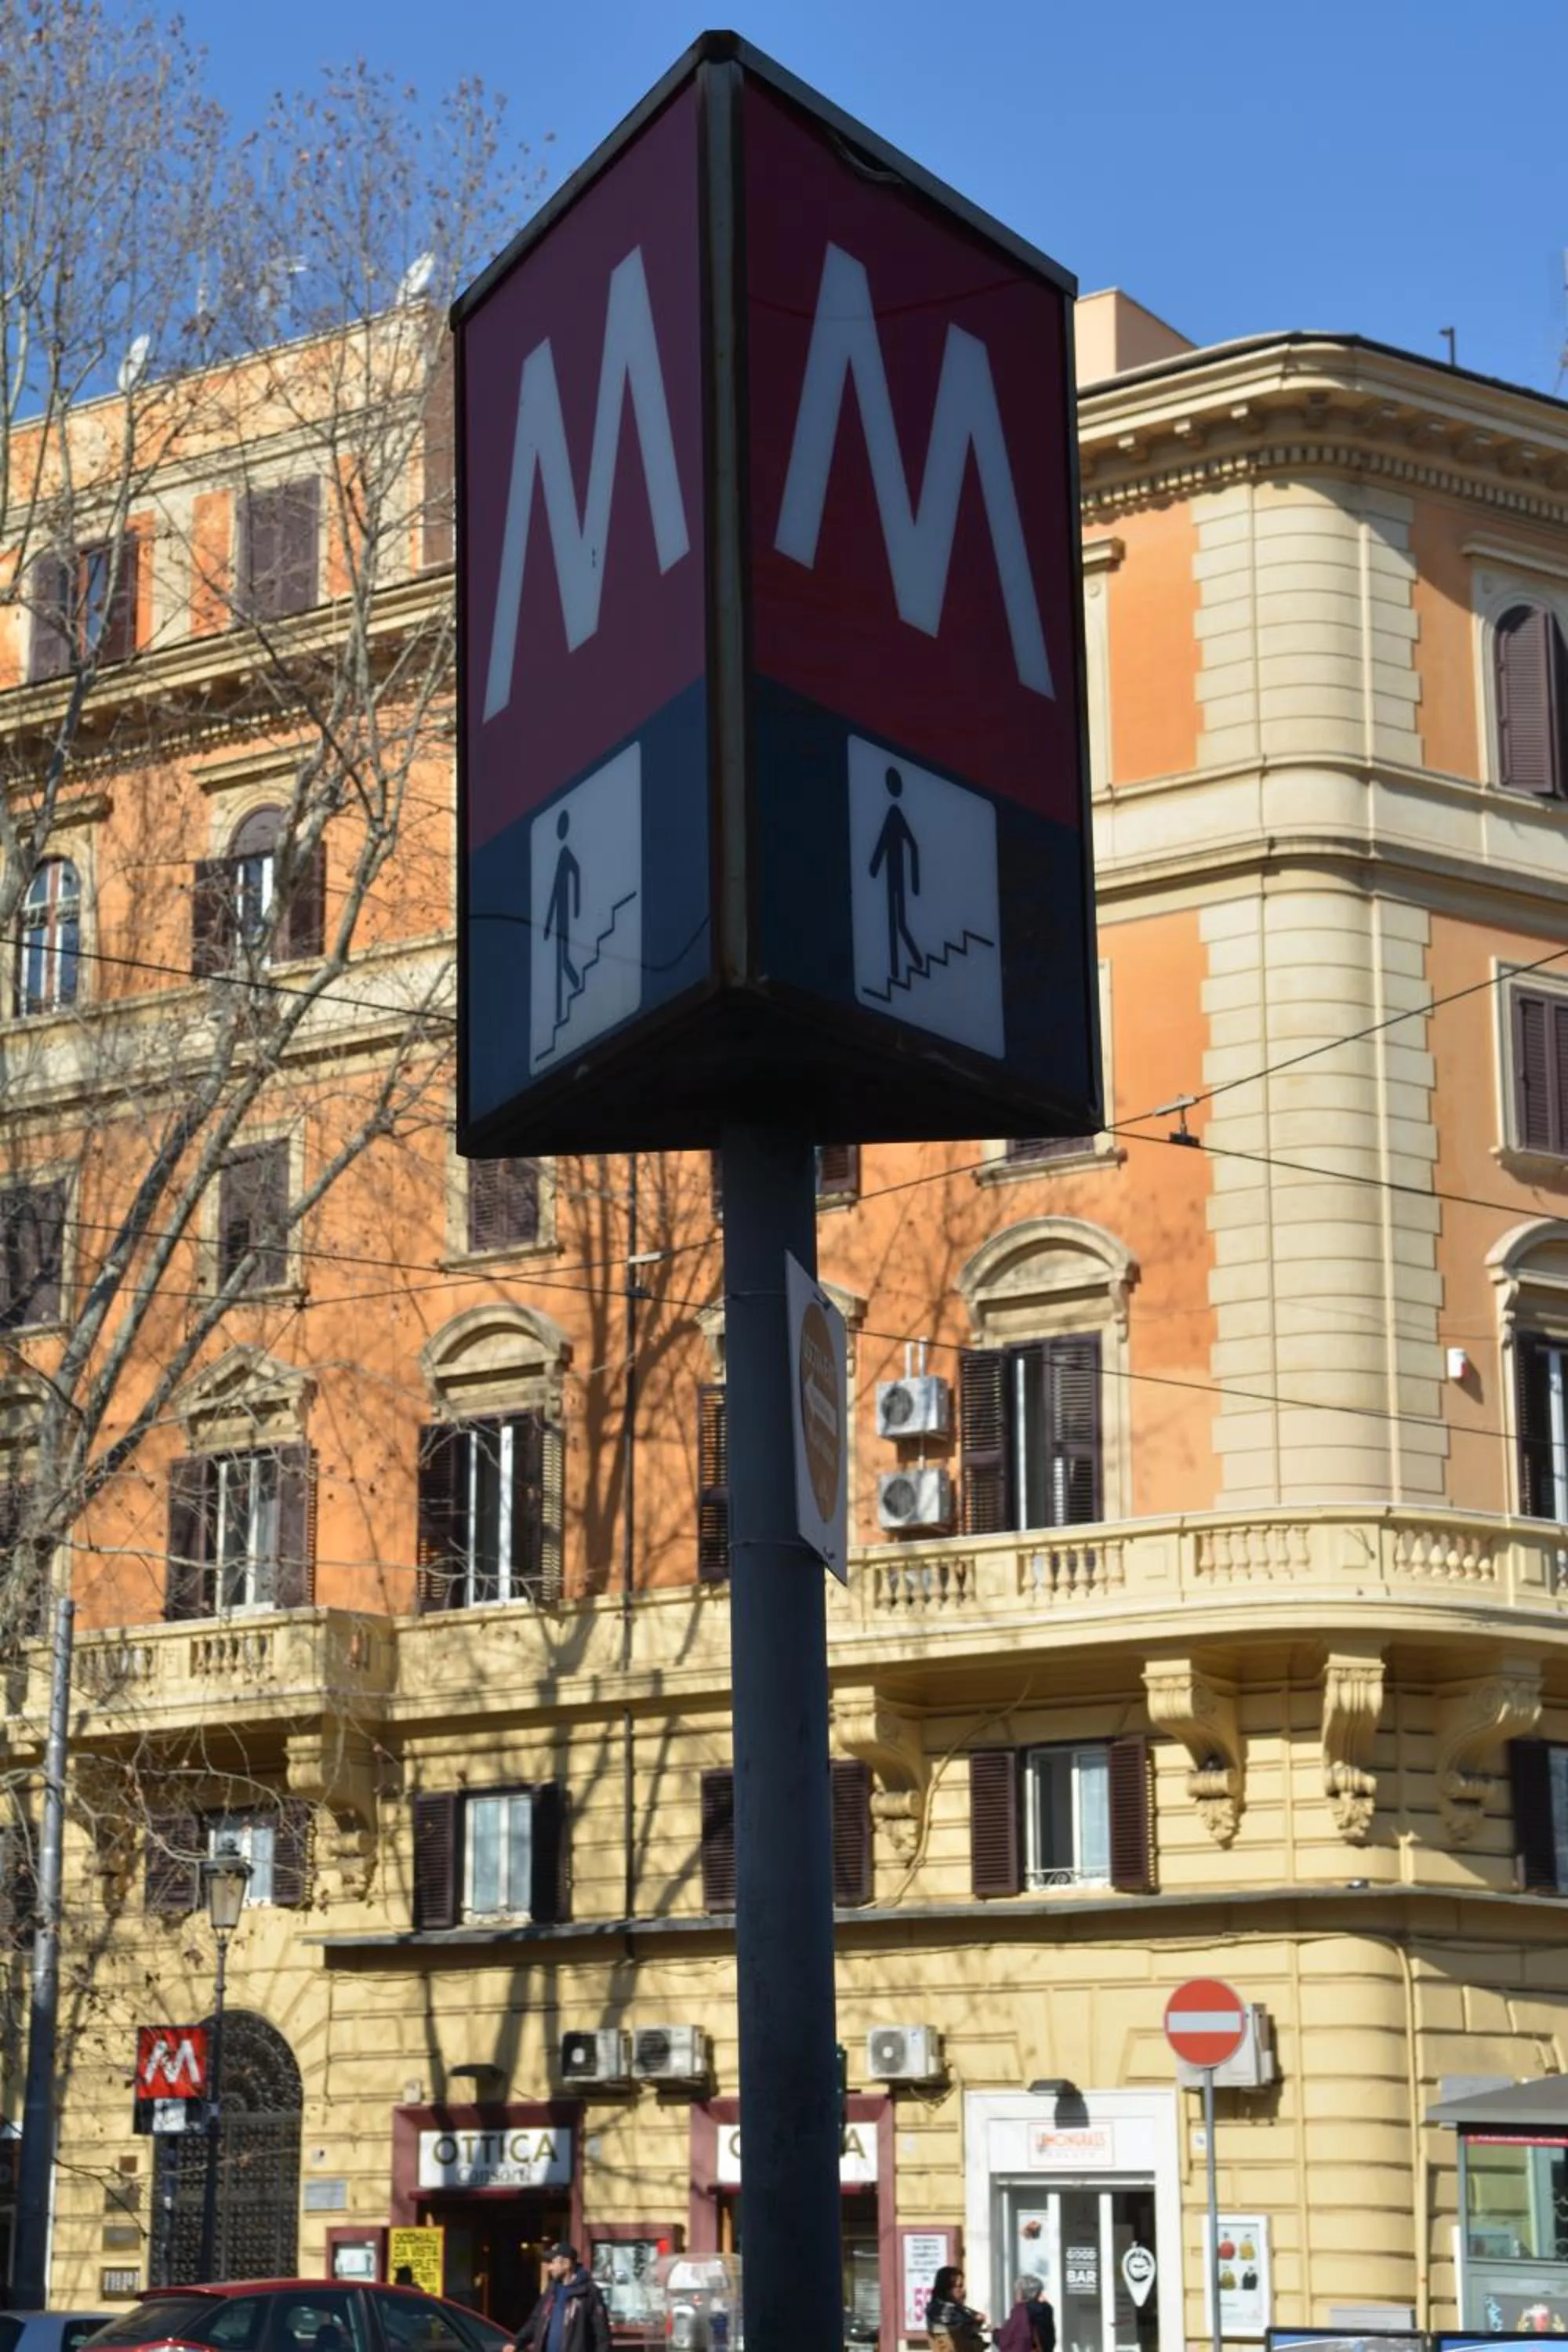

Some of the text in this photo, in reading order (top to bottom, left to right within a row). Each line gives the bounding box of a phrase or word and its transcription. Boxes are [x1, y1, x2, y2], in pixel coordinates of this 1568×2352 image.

[483, 245, 690, 724] M
[775, 241, 1055, 701] M
[144, 2039, 201, 2083] M
[434, 2133, 559, 2165] OTTICA
[1066, 2270, 1098, 2284] BAR
